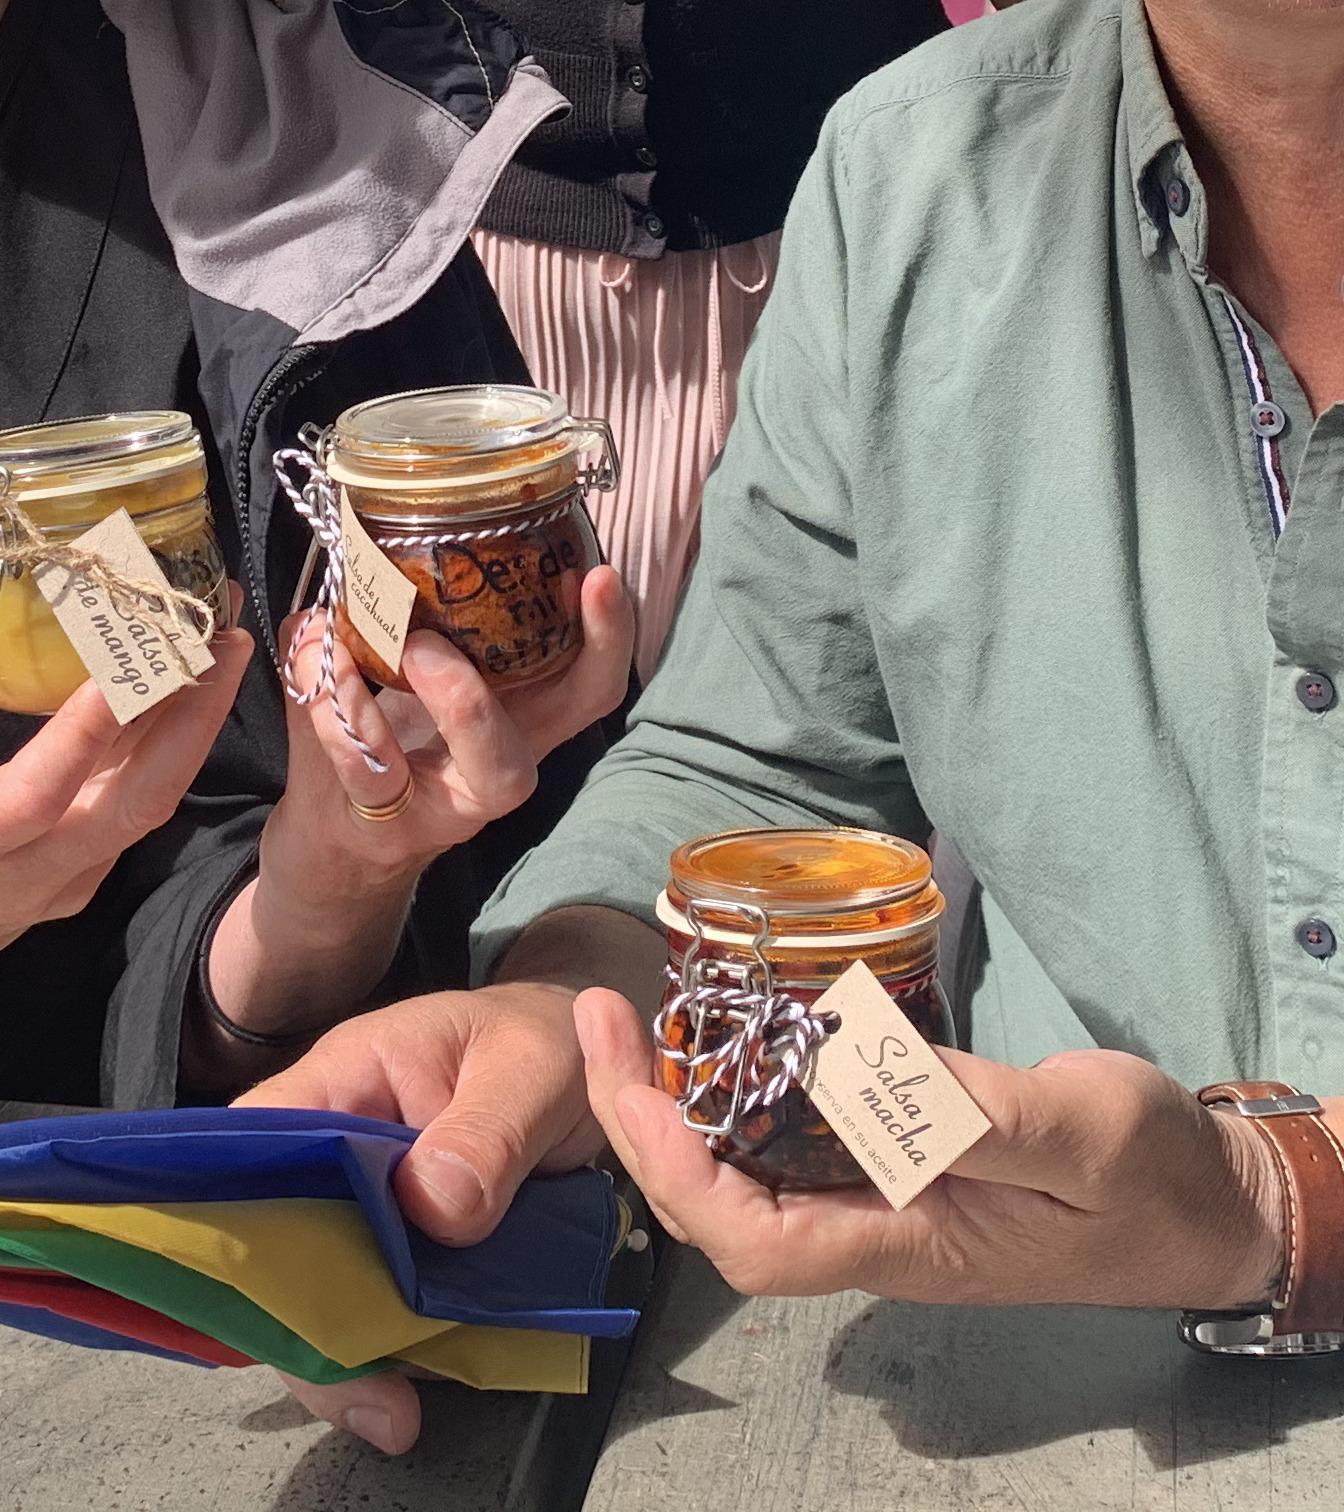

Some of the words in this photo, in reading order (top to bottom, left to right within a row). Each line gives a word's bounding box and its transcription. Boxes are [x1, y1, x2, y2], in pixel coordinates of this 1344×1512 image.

[343, 534, 363, 586] Salsa
[362, 574, 376, 601] de
[350, 581, 399, 644] cacahuate
[90, 613, 150, 696] mango
[854, 1035, 930, 1120] Salsa
[842, 1115, 856, 1132] en
[854, 1131, 869, 1148] su
[867, 1146, 898, 1184] aceite
[858, 1086, 933, 1167] macha
